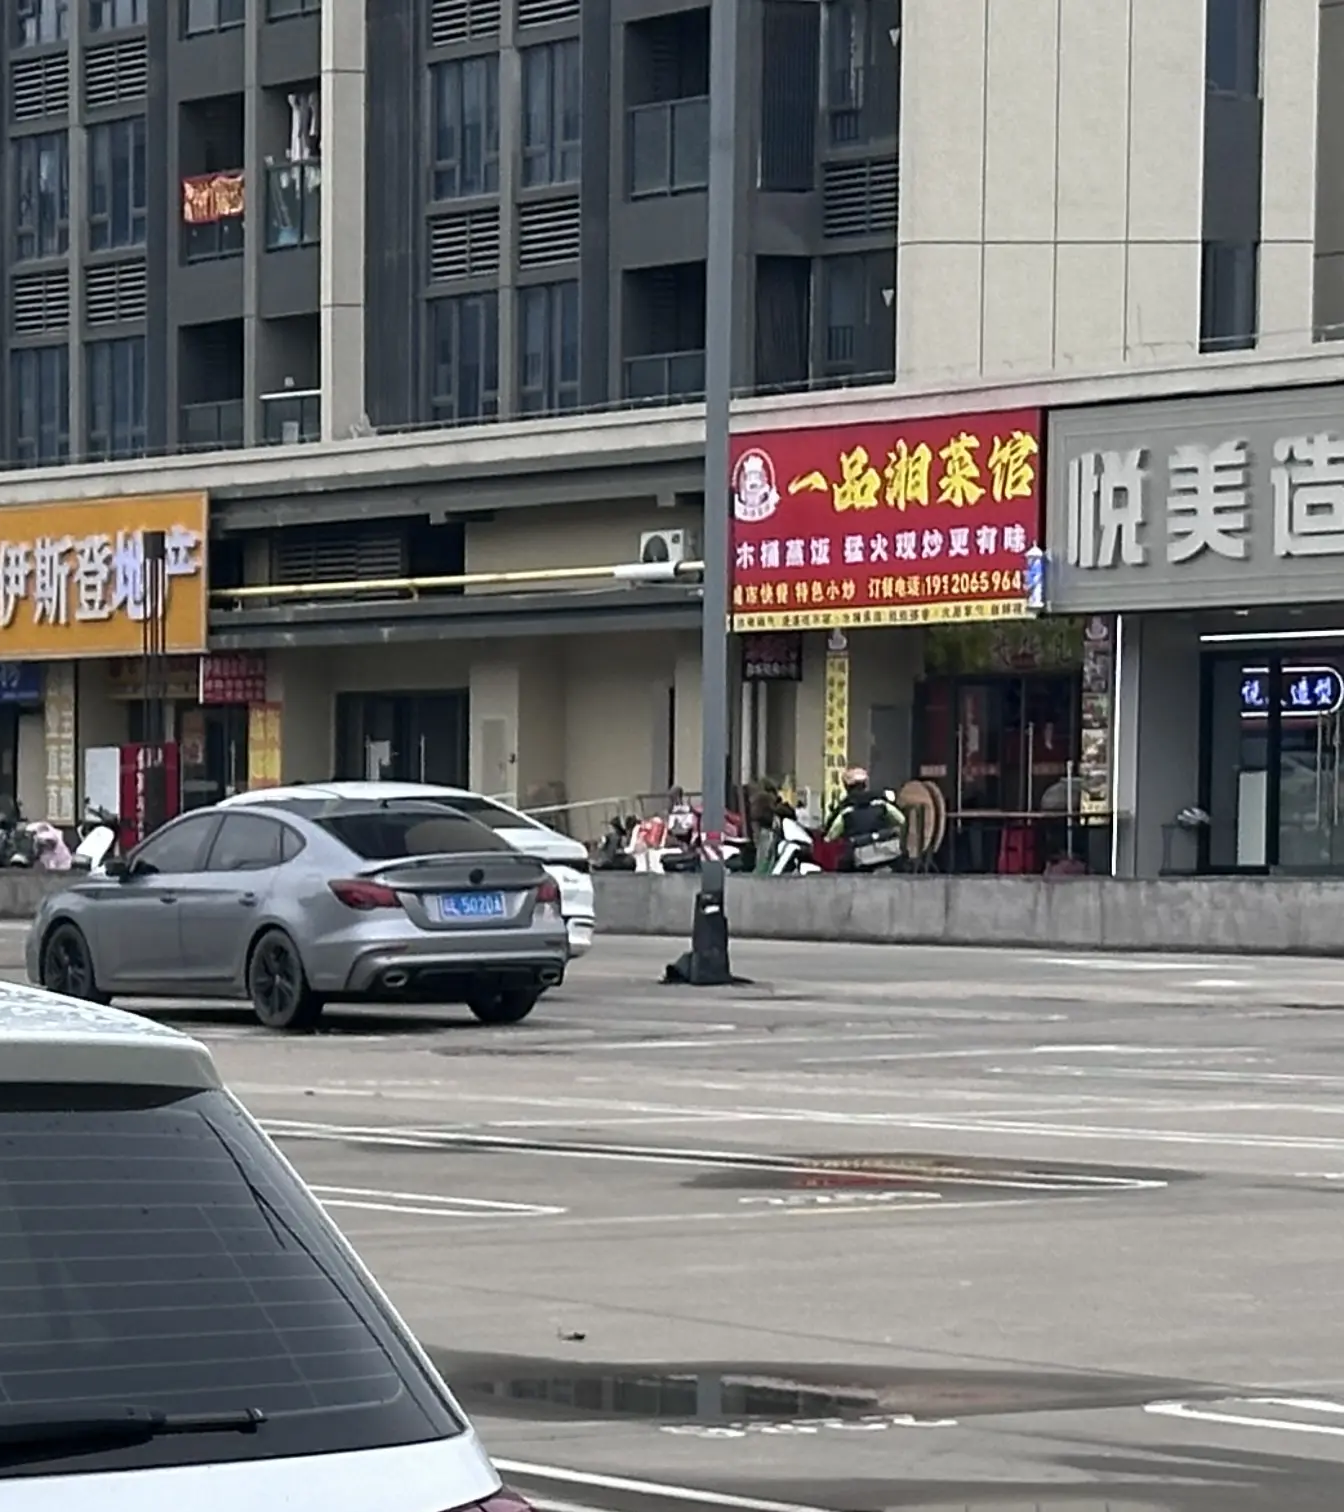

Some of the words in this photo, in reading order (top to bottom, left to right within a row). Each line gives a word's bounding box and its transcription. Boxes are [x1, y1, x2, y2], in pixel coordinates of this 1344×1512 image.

[787, 430, 1039, 512] 一品湘菜馆
[735, 537, 831, 570] 木桶蒸饭
[843, 523, 1027, 564] 猛火现炒更有味
[795, 578, 855, 603] 特色小炒
[1241, 676, 1332, 706] 悦造型
